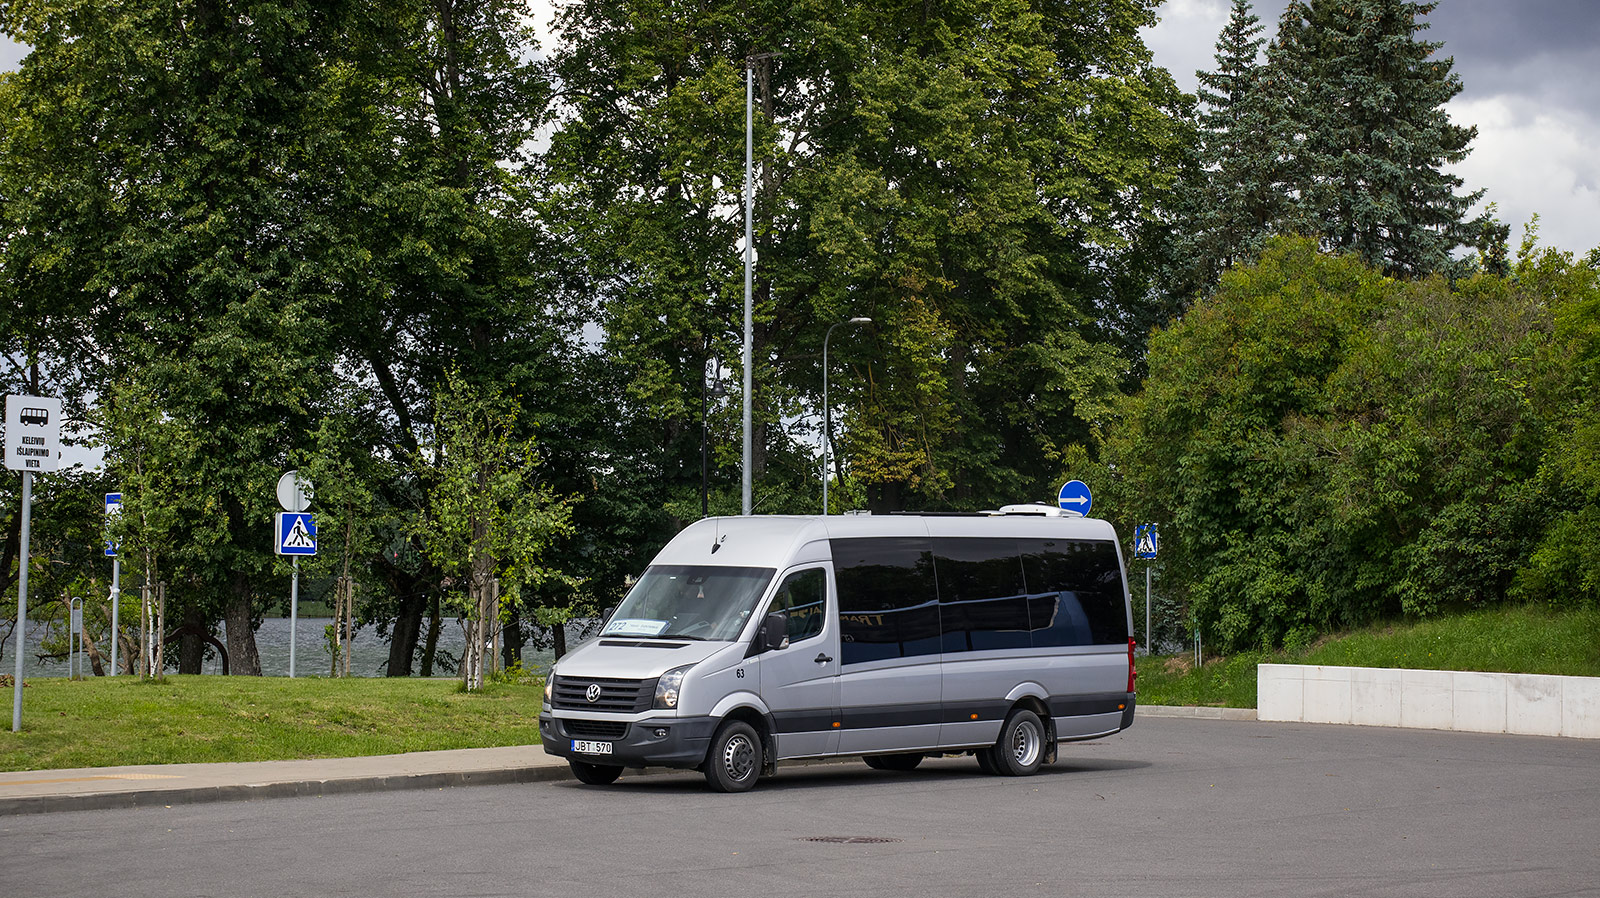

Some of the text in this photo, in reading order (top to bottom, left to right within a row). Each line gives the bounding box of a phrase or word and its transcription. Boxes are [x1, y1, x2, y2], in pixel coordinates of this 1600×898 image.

[16, 446, 49, 457] IŠLAIPINIMO
[26, 459, 40, 468] VIETA
[609, 622, 627, 631] 272
[736, 668, 745, 679] 63
[575, 741, 592, 752] JBT
[596, 743, 612, 753] 570
